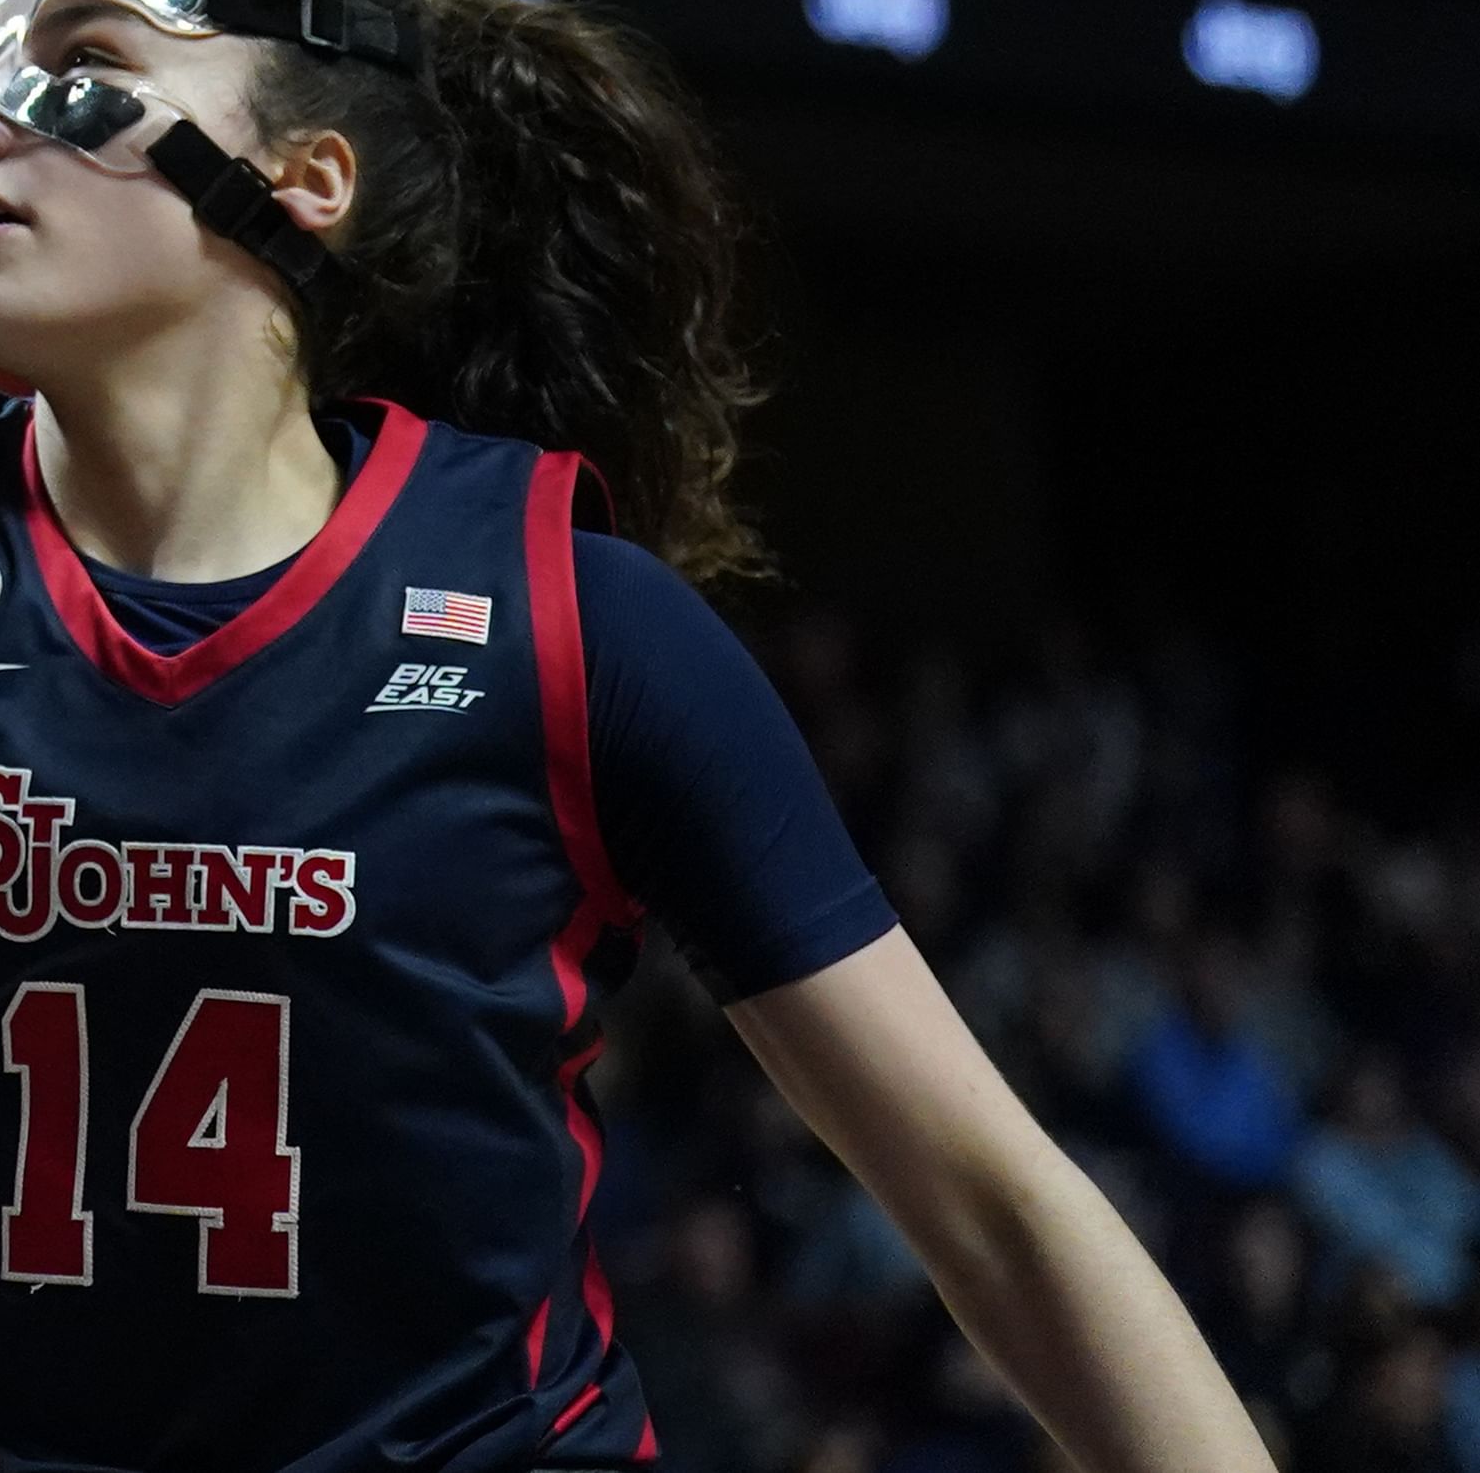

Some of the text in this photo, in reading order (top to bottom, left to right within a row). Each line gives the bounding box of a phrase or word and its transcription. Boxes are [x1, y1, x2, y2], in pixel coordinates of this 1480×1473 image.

[388, 663, 469, 687] BIG
[374, 684, 485, 708] EAST
[0, 981, 301, 1299] 14
